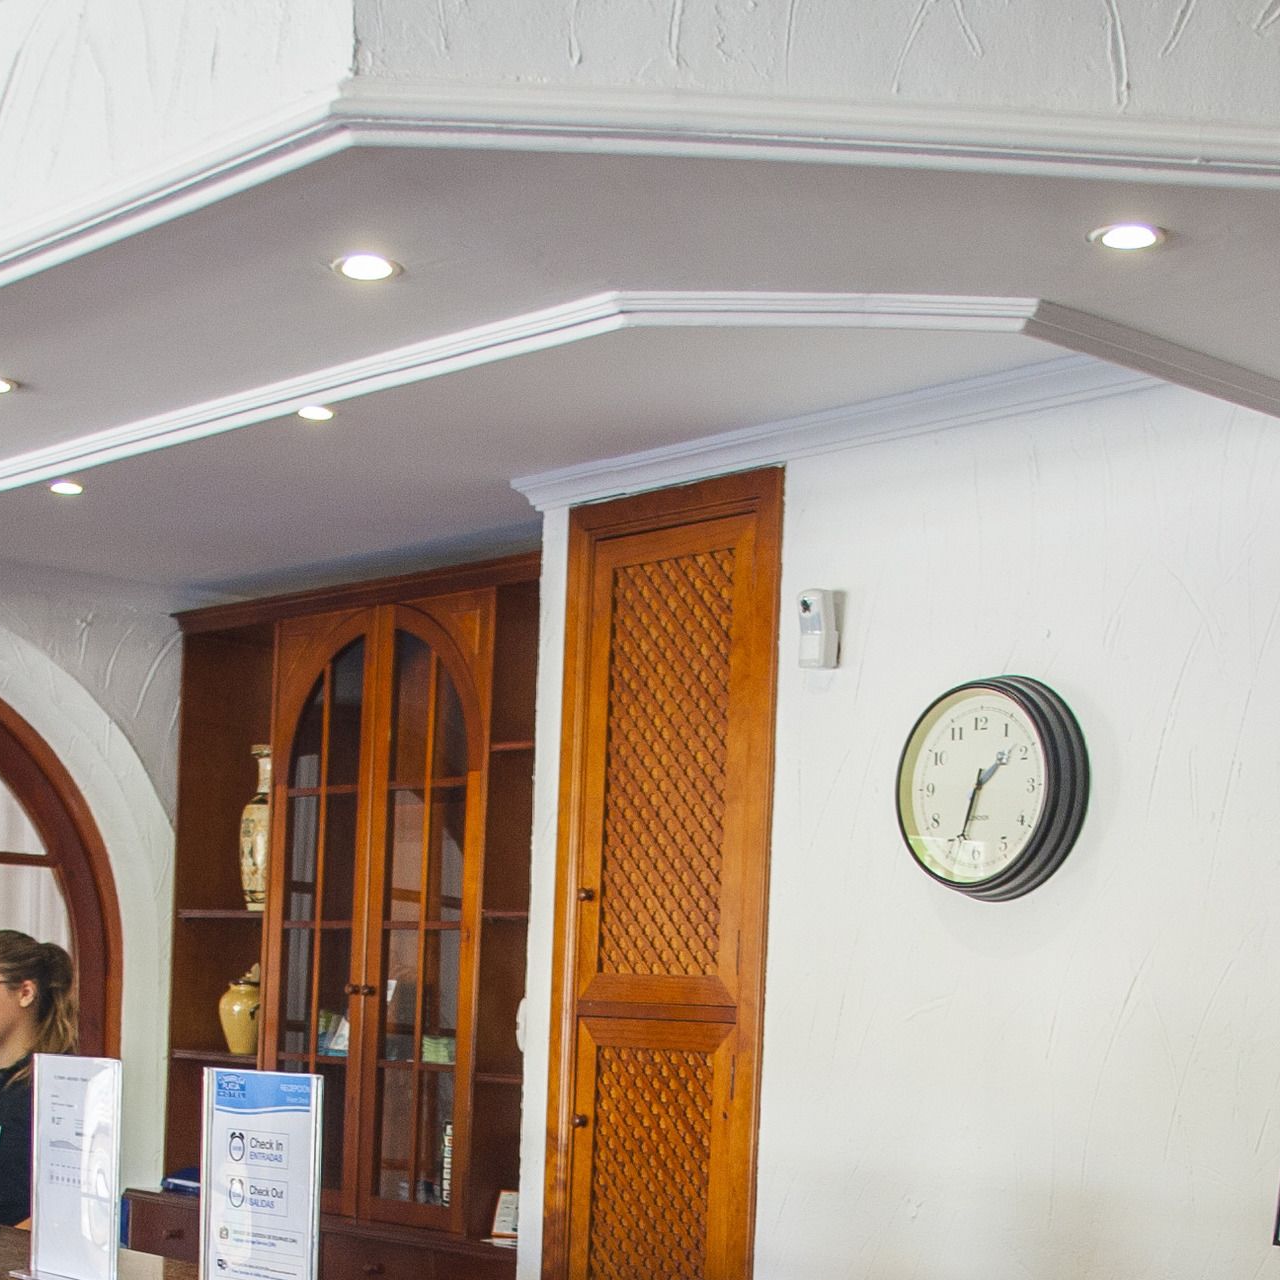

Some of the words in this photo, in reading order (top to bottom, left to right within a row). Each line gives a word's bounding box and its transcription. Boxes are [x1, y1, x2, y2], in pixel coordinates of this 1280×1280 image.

[973, 716, 988, 731] 12
[1004, 723, 1009, 737] 1
[951, 727, 963, 741] 11
[933, 751, 947, 766] 10
[1020, 745, 1028, 760] 2
[926, 783, 935, 797] 9
[1026, 778, 1035, 793] 3
[931, 813, 940, 829] 8
[250, 1137, 274, 1151] Check
[276, 1140, 284, 1151] In
[249, 1151, 283, 1163] ENTRADAS
[250, 1185, 270, 1197] Check
[271, 1188, 284, 1199] Out
